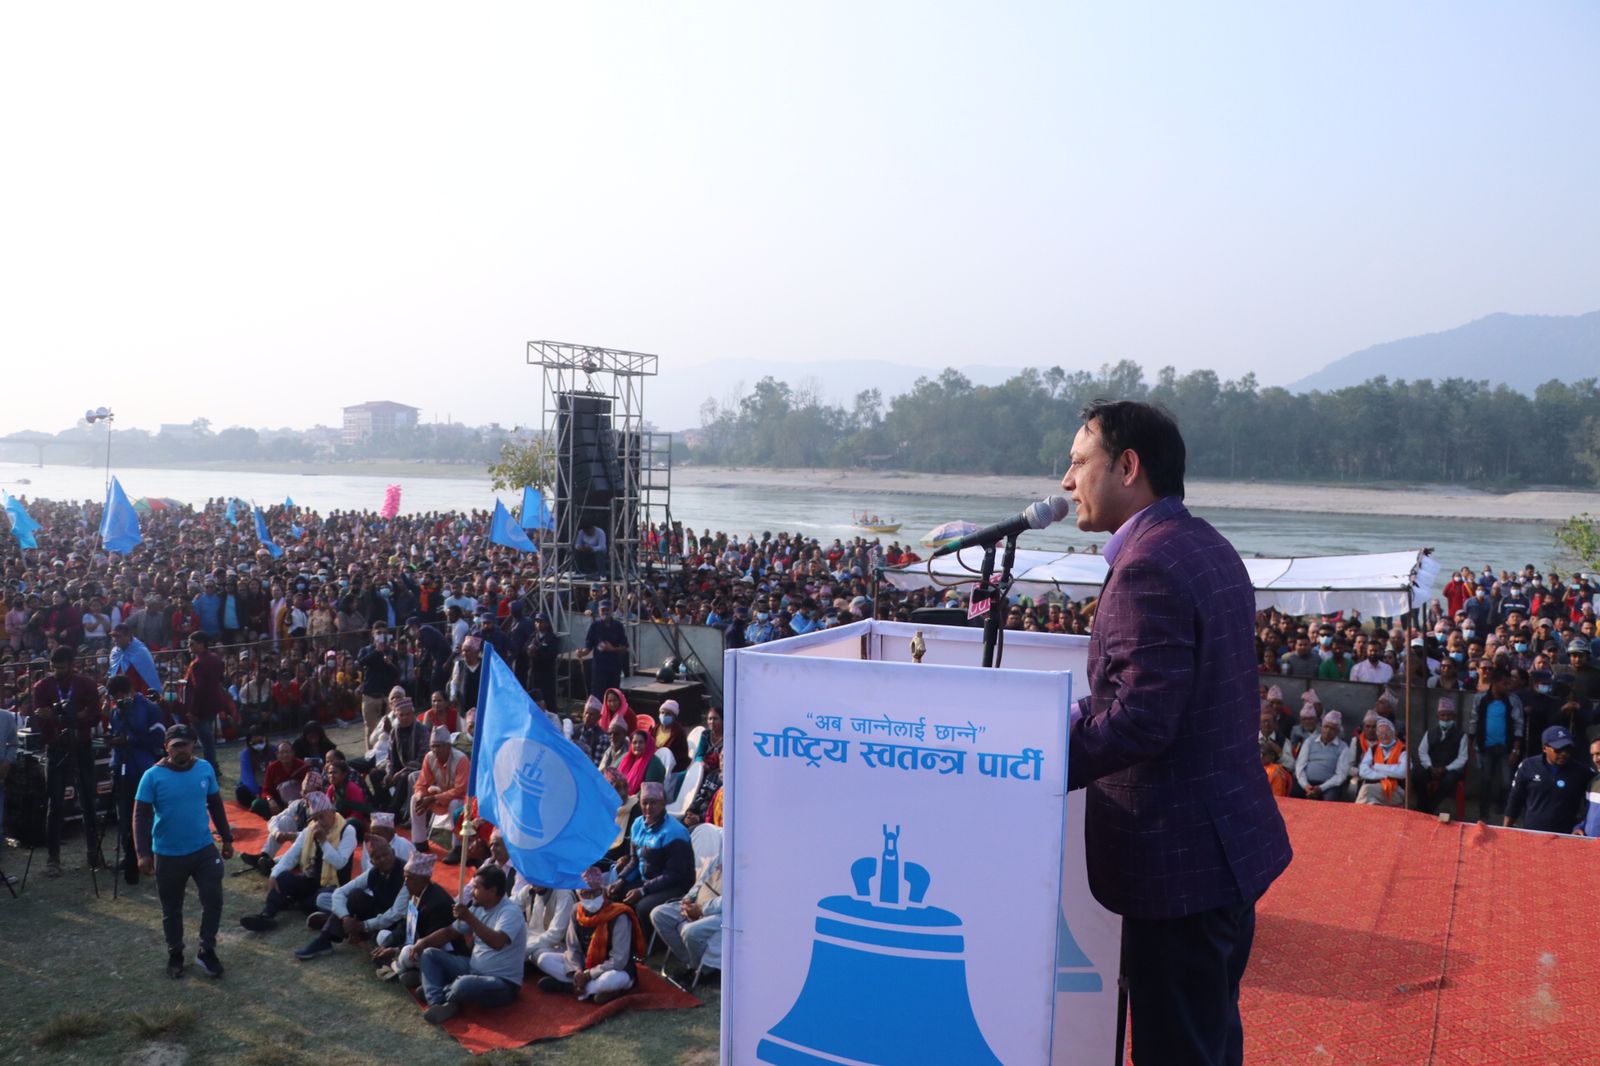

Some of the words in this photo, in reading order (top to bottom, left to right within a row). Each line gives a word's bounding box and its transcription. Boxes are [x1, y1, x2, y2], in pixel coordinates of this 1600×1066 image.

[850, 713, 926, 742] जान्नेलाई
[753, 726, 850, 768] राष्ट्रिय
[860, 741, 967, 775] स्वतन्त्र
[977, 748, 1044, 781] पार्टी
